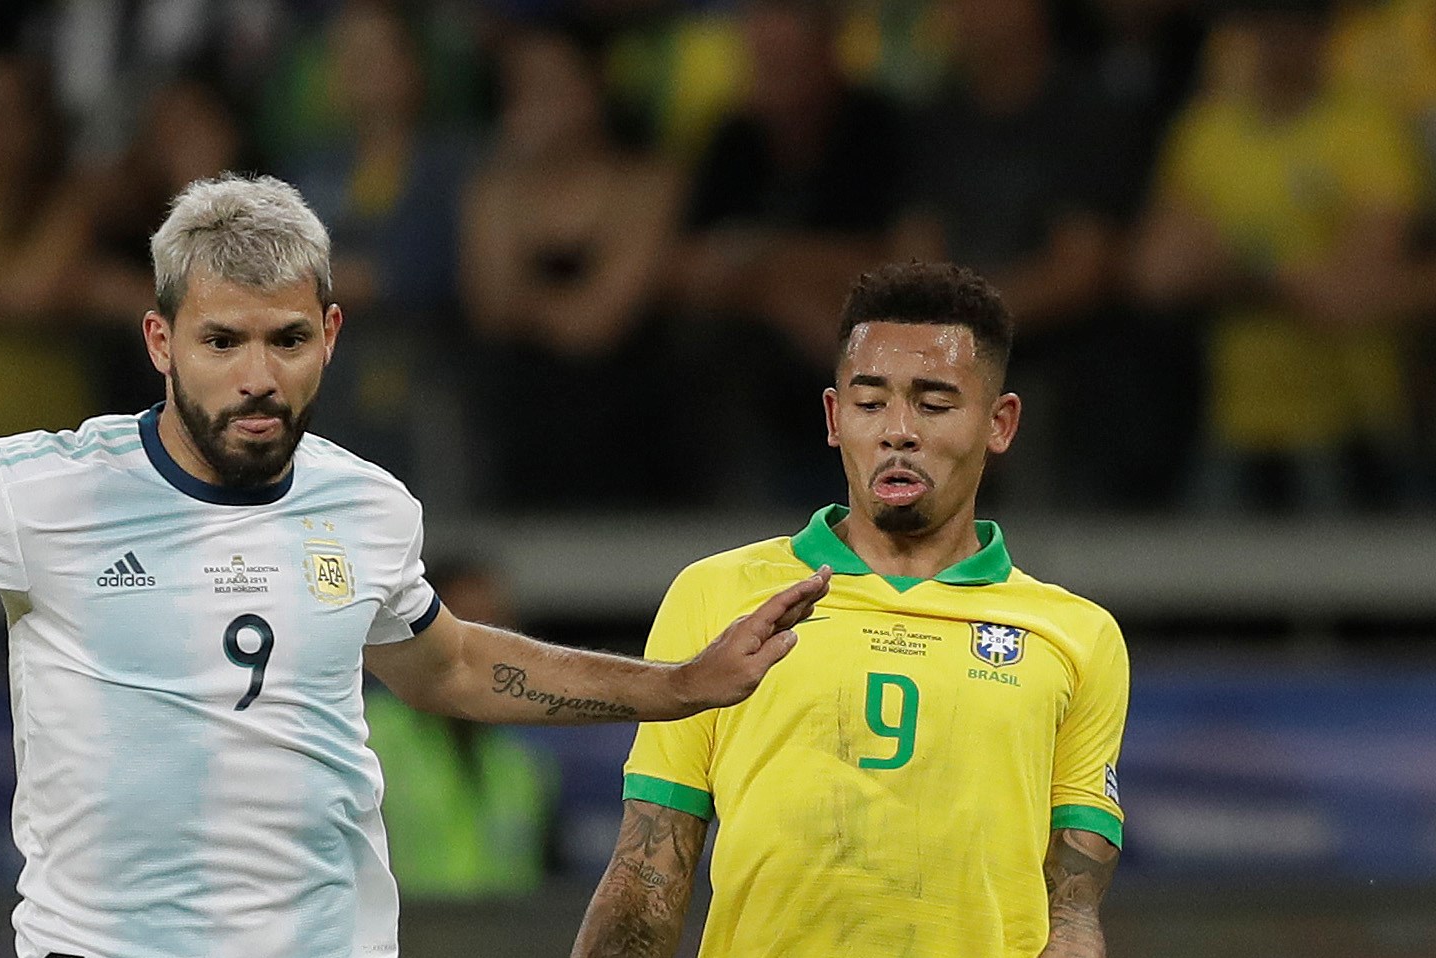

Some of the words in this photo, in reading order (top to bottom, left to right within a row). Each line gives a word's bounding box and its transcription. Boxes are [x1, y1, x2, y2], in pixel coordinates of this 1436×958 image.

[318, 555, 346, 589] AFA
[97, 574, 156, 587] adidas
[214, 577, 224, 585] 02
[214, 586, 232, 594] BELO
[232, 585, 269, 593] HORIZONTE
[862, 628, 892, 637] BRASIL
[906, 633, 943, 642] ARGENTINA
[989, 636, 1007, 644] CBF
[871, 645, 888, 653] BELO
[889, 647, 927, 657] HORIZONTE
[908, 641, 927, 649] 2019
[223, 613, 275, 712] 9
[968, 668, 1022, 688] BRASIL
[858, 672, 920, 770] 9
